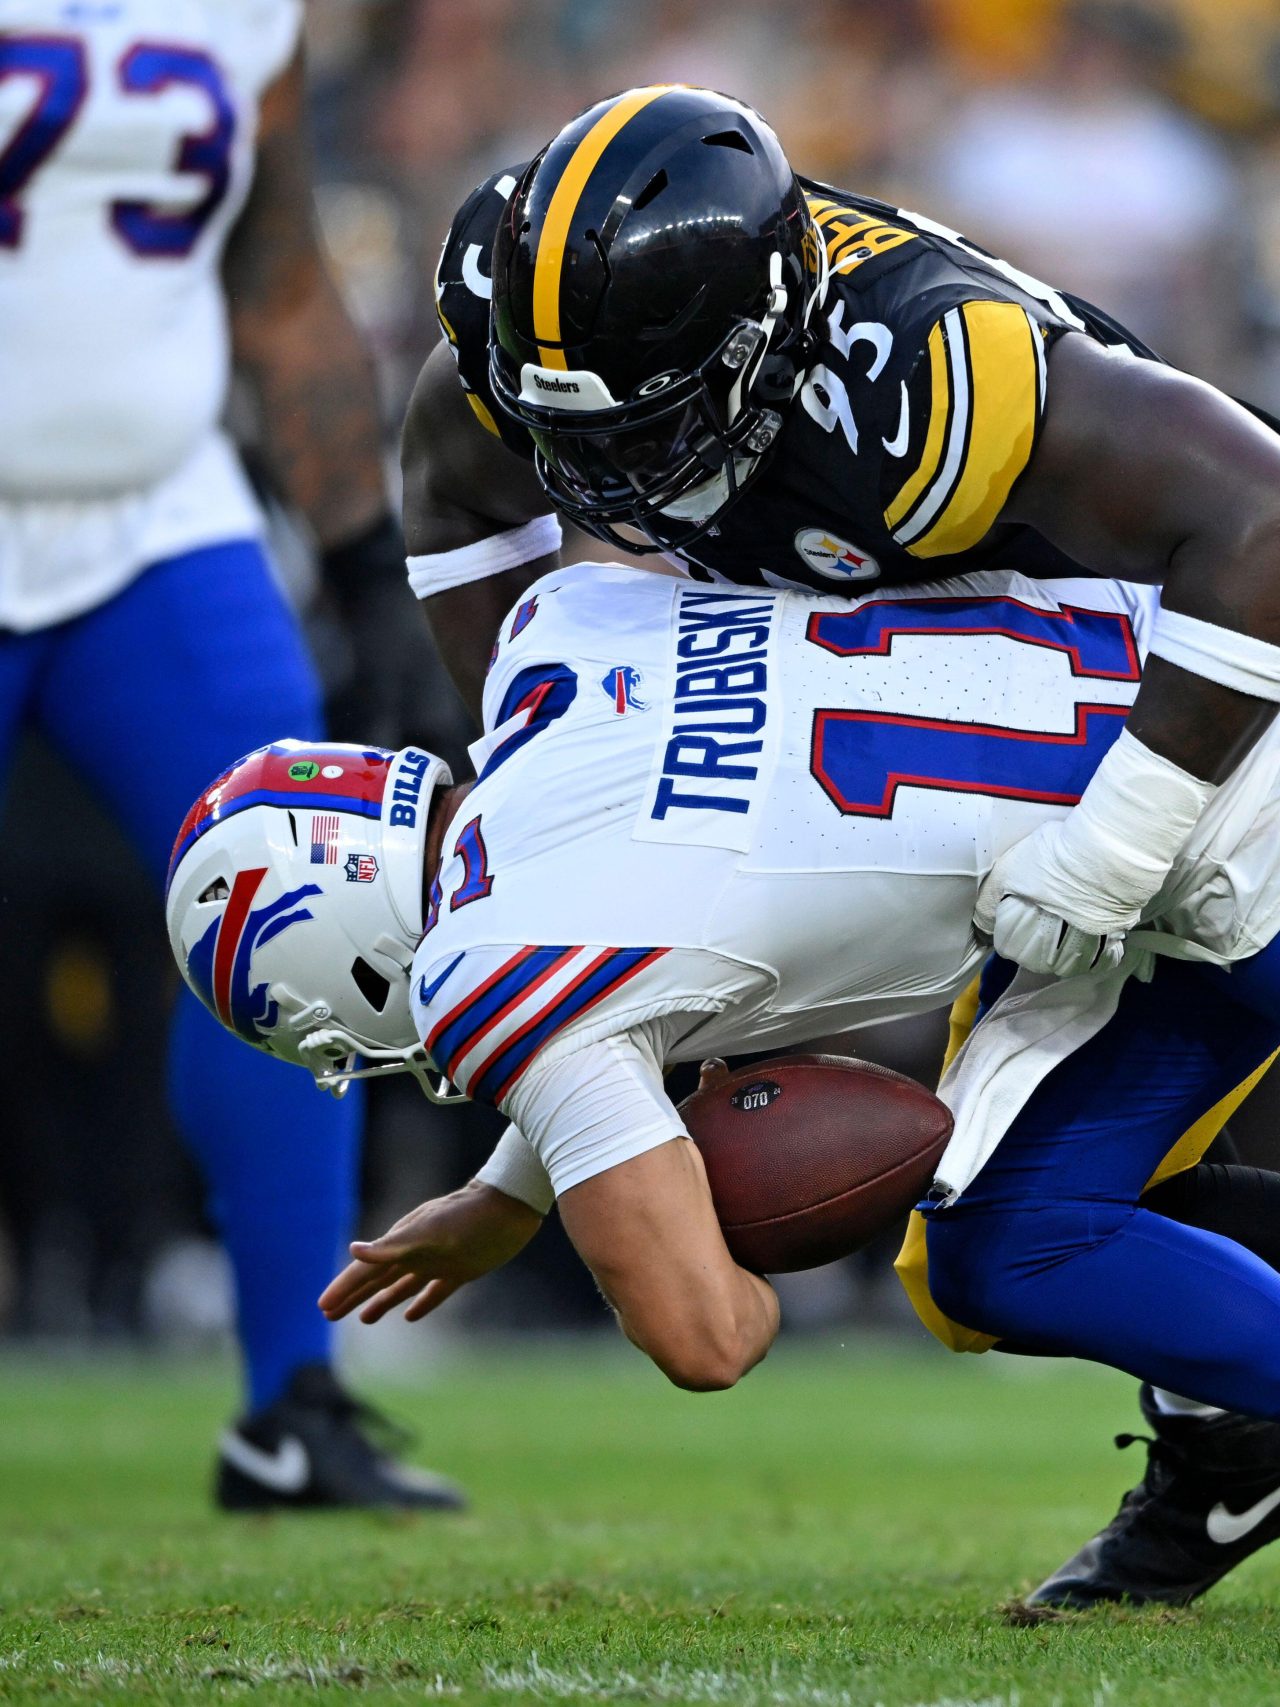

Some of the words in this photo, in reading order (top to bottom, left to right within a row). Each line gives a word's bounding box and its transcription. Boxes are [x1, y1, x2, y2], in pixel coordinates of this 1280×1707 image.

[0, 31, 237, 263] 73
[533, 373, 580, 393] Steelers
[800, 298, 894, 457] 95
[651, 591, 777, 821] TRUBISKY
[805, 595, 1142, 820] 11
[389, 750, 431, 829] BILLS
[358, 856, 377, 881] NFL
[743, 1091, 768, 1110] 070
